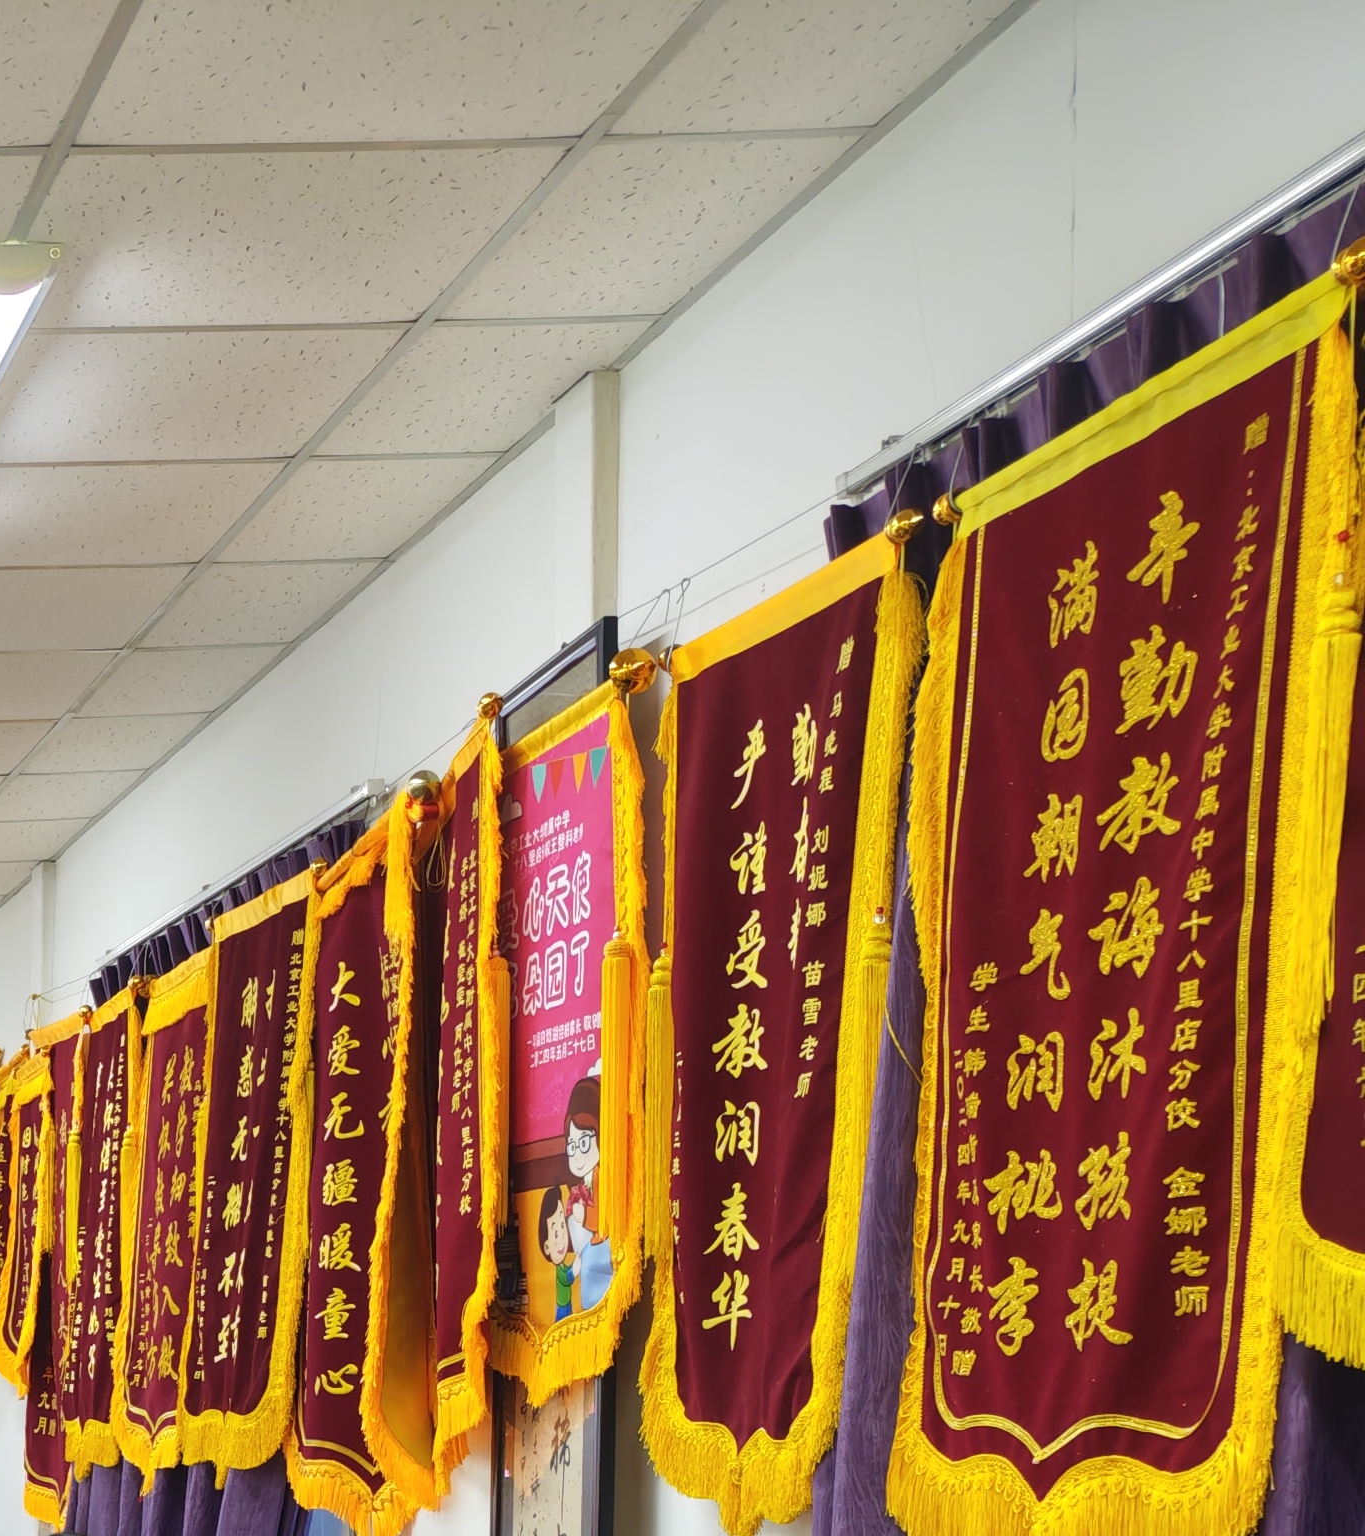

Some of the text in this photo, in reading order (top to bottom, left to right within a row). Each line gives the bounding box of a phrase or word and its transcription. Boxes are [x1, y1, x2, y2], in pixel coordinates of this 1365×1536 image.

[314, 961, 365, 1395] 大爱无疆暖童心
